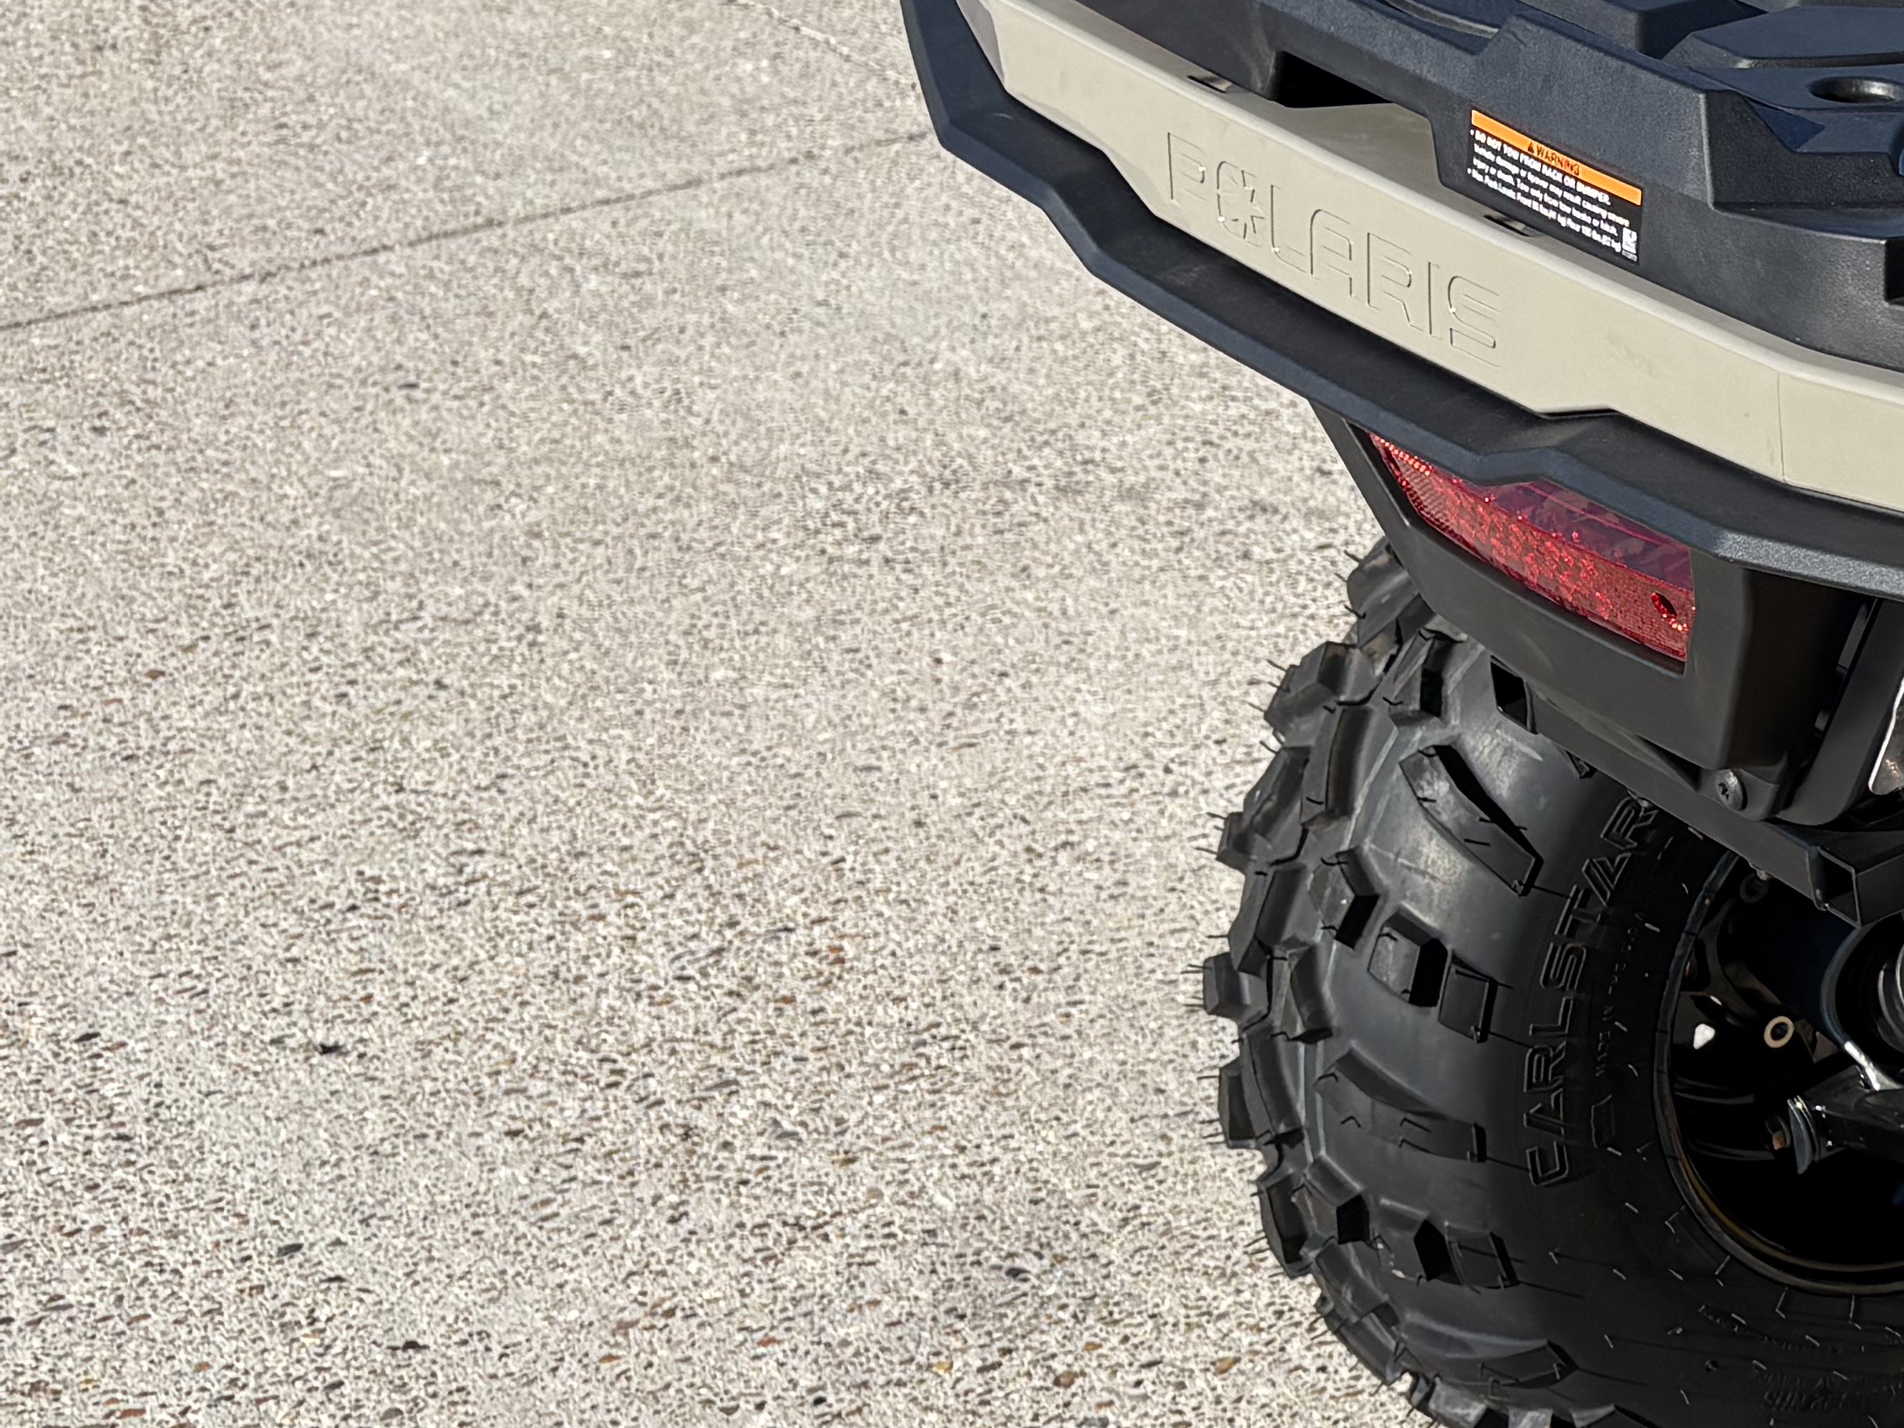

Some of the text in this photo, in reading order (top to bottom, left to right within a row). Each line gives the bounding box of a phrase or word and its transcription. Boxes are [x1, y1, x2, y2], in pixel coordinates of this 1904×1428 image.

[1166, 131, 1504, 369] POLARIS
[1536, 145, 1580, 176] WARNING
[1522, 786, 1662, 1189] CARLSTAR
